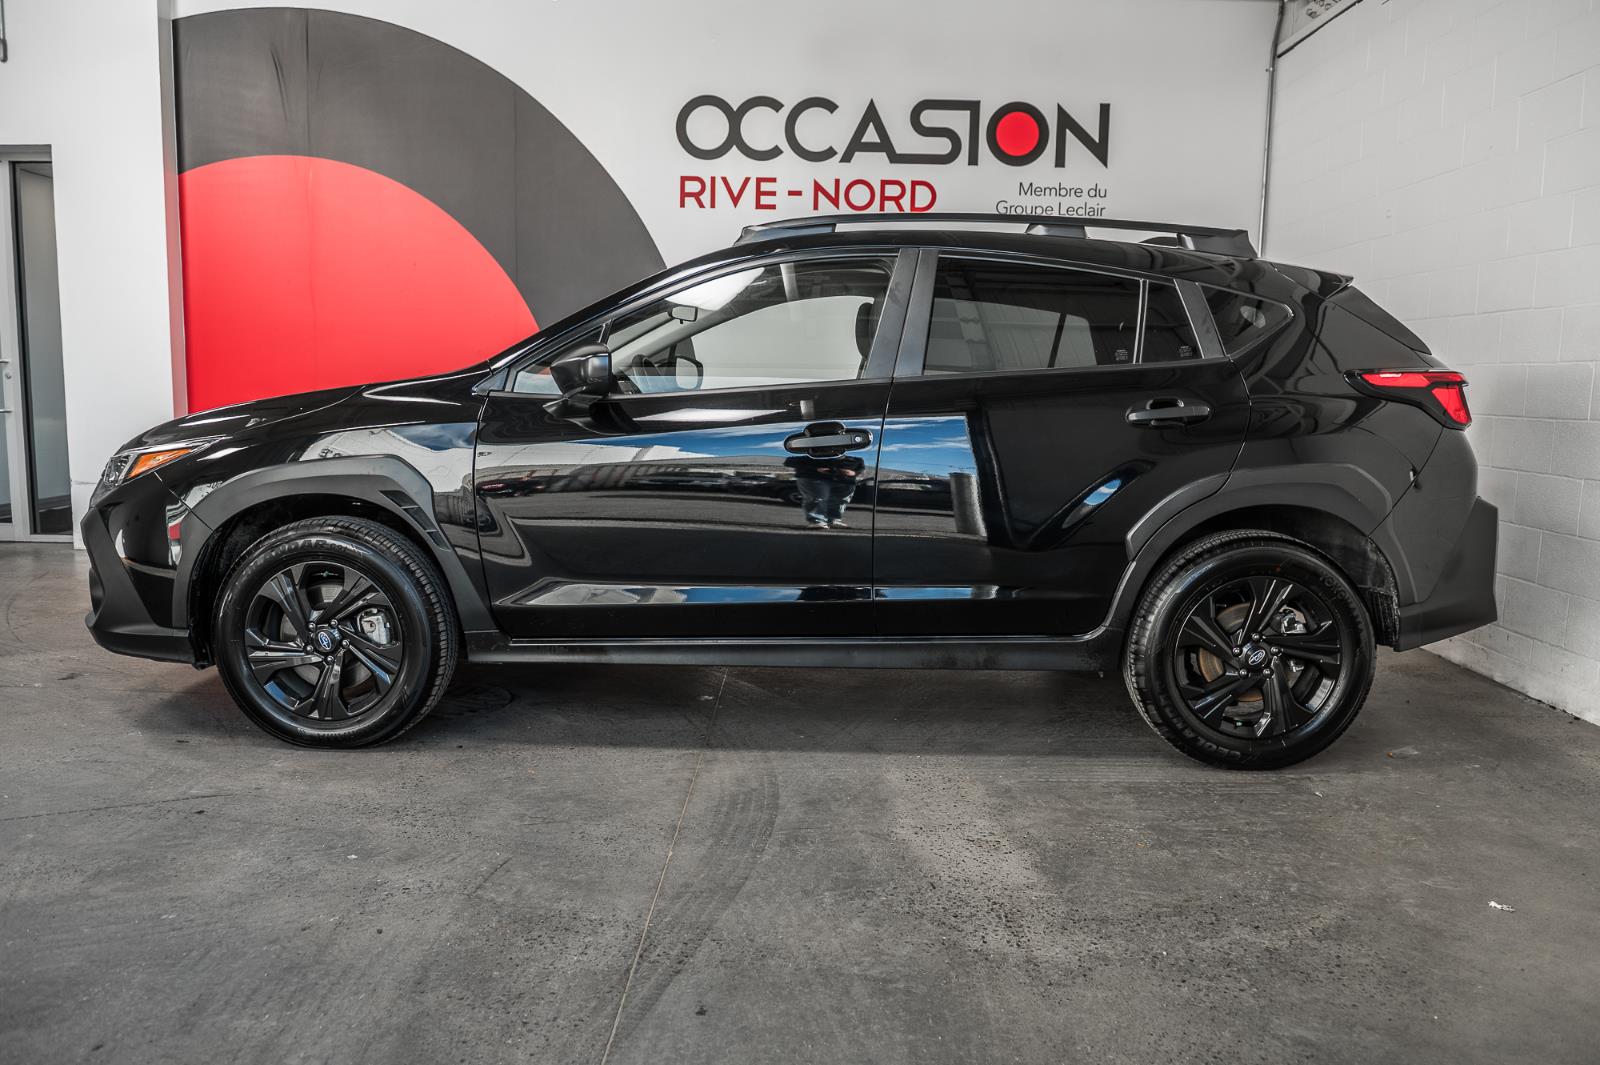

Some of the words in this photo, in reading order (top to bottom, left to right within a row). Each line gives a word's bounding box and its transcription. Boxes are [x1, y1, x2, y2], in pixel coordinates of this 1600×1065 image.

[675, 94, 1111, 168] OCCASION
[1018, 181, 1083, 198] Membre
[1087, 182, 1107, 198] du
[995, 199, 1054, 215] Groupe
[1058, 201, 1106, 217] Leclair
